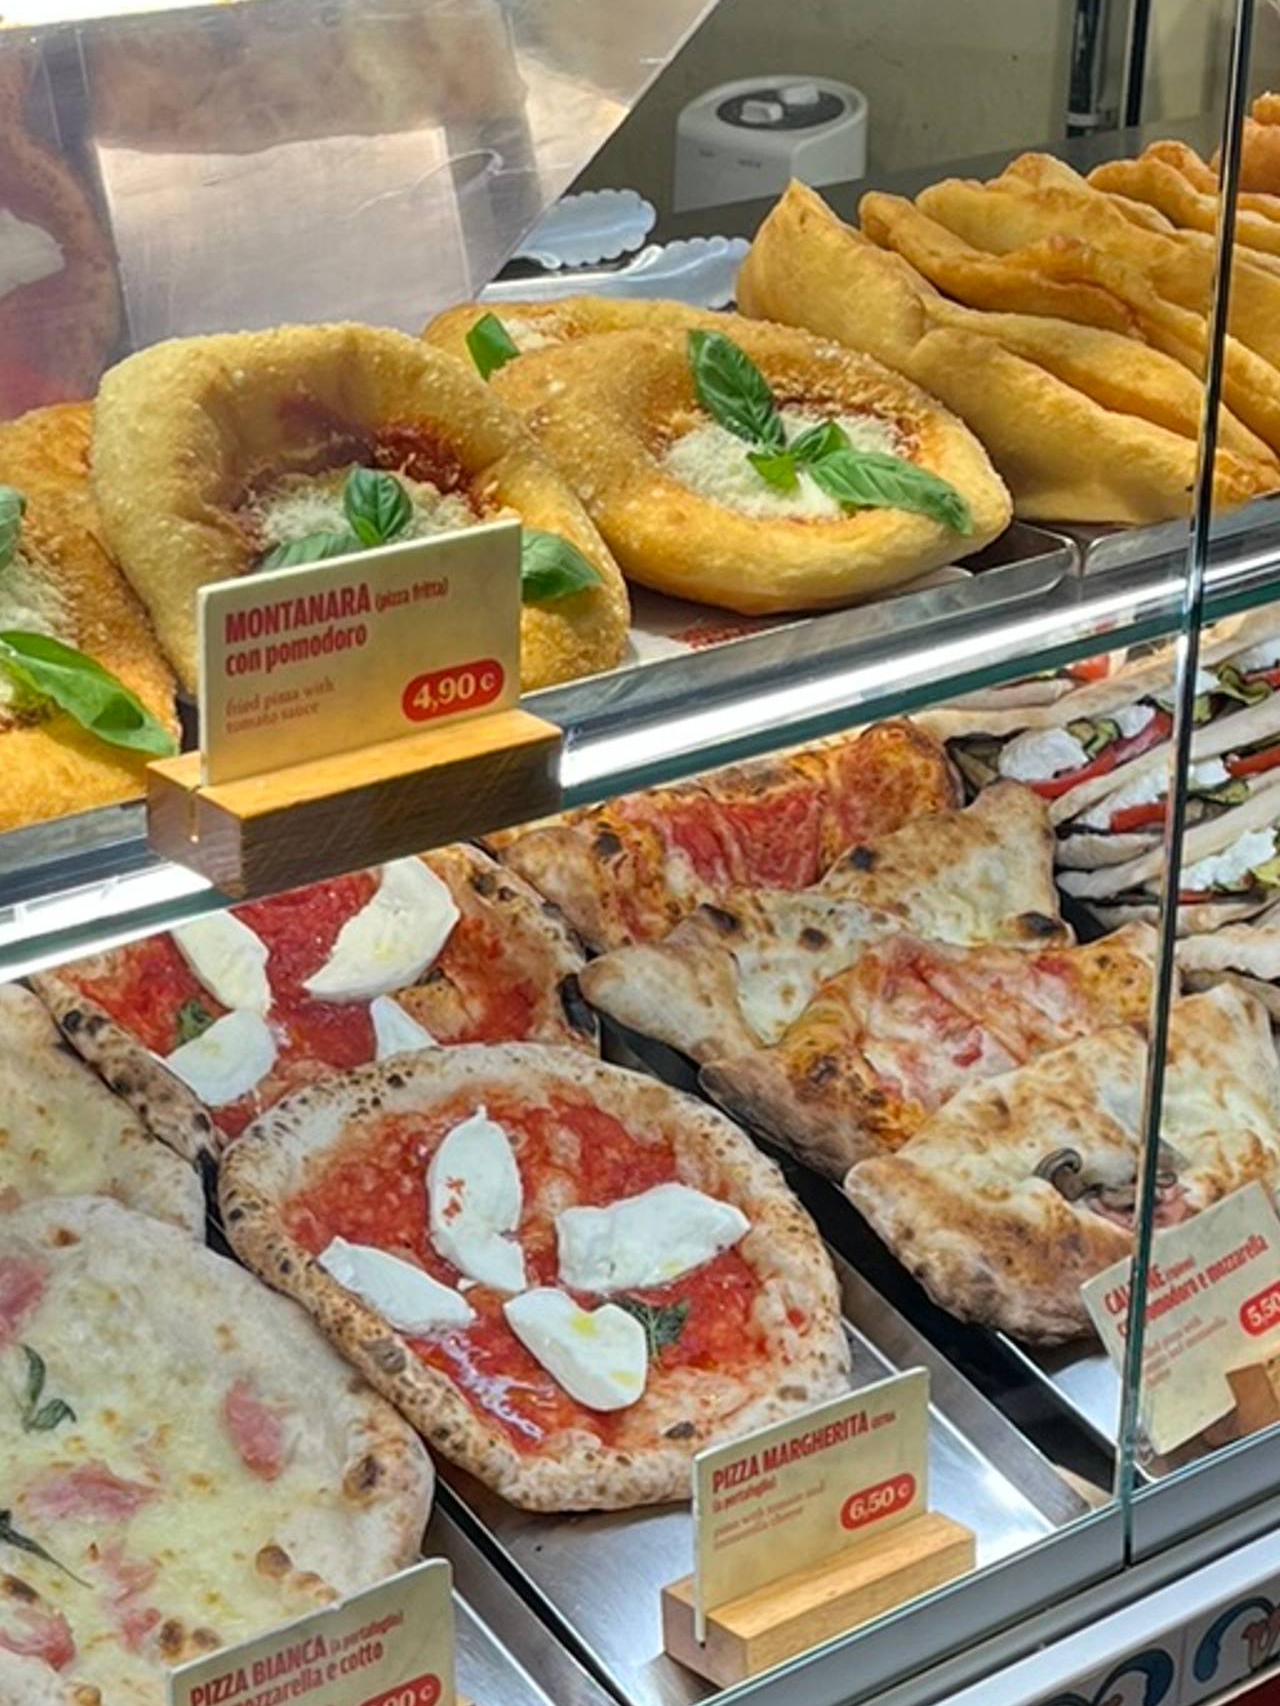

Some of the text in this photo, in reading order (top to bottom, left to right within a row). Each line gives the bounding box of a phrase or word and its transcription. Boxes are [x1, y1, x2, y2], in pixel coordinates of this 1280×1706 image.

[225, 583, 371, 644] MONTANARA
[225, 624, 368, 677] con pomodoro
[412, 672, 476, 711] 4,90
[713, 1410, 869, 1494] PIZZA MARGHERITA
[849, 1486, 895, 1520] 6,50
[252, 1634, 327, 1687] BIANCA
[326, 1663, 338, 1681] e
[339, 1641, 384, 1675] cotto
